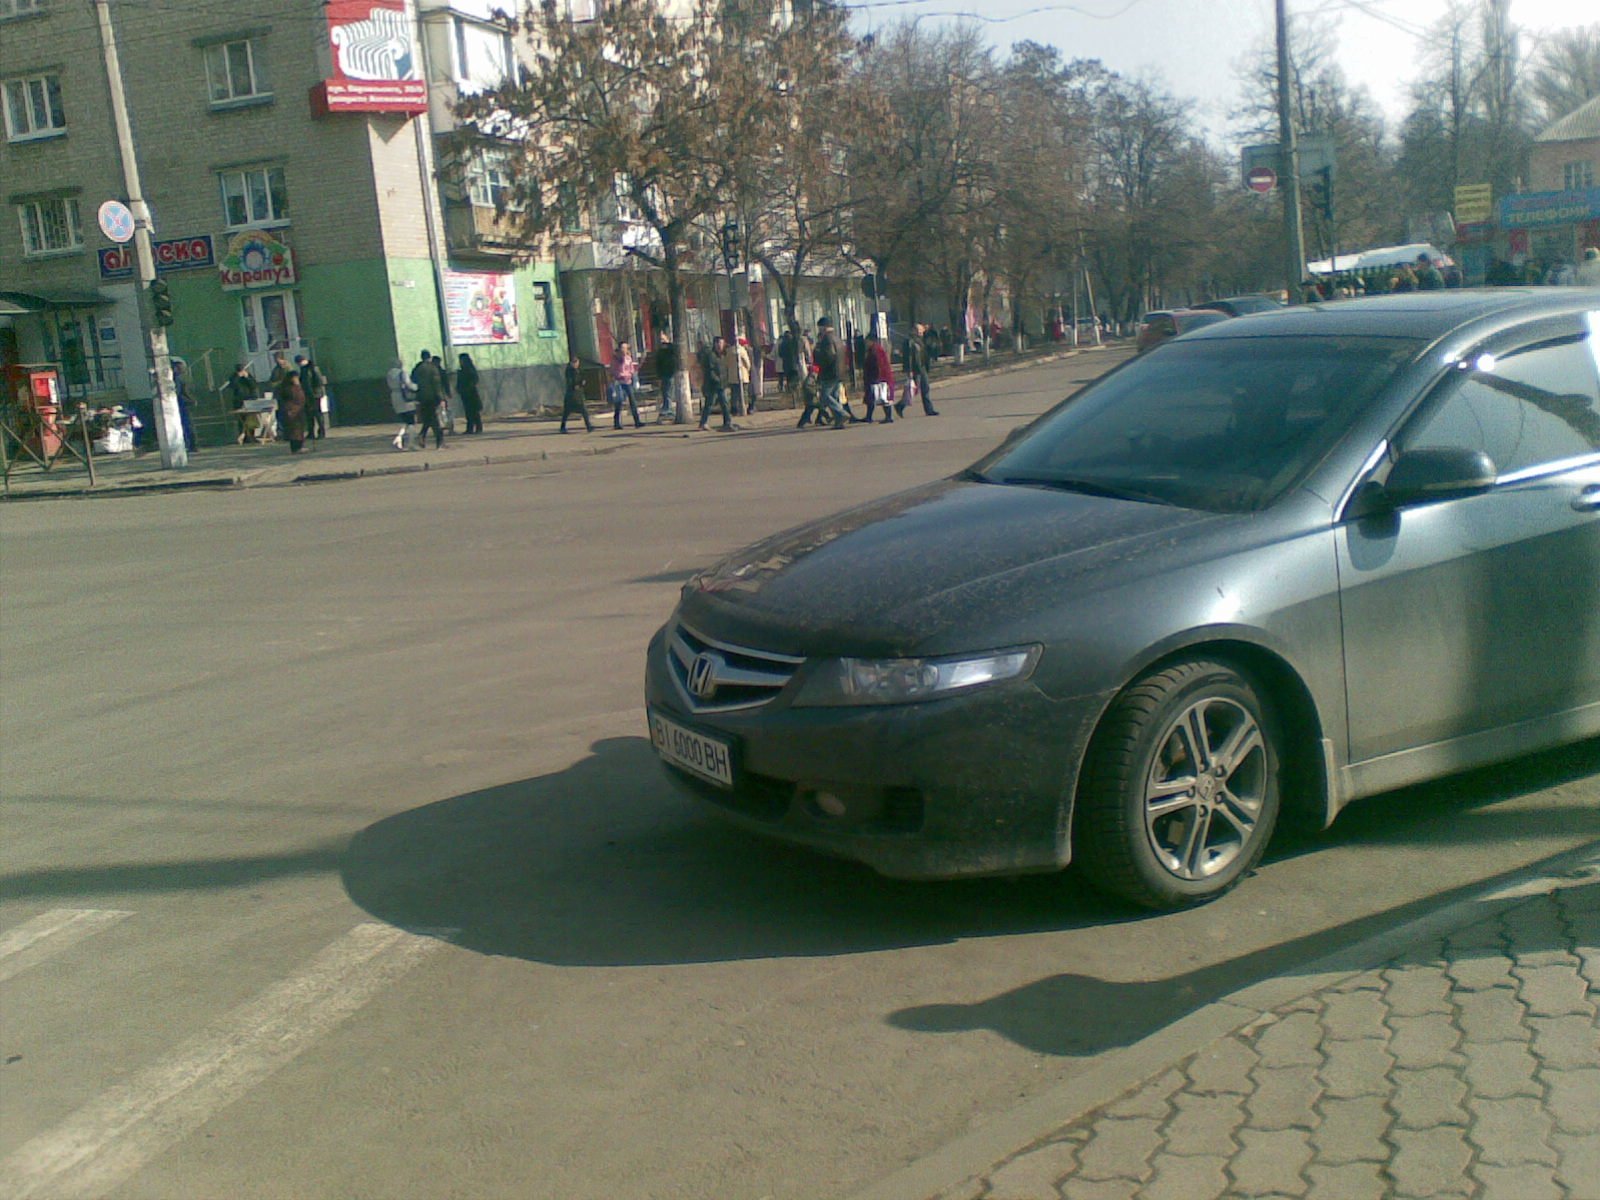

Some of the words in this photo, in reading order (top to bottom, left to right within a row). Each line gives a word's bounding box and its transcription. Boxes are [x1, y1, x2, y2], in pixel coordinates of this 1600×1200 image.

[104, 238, 209, 270] алска
[221, 267, 291, 287] Карапуз
[703, 741, 728, 778] BH
